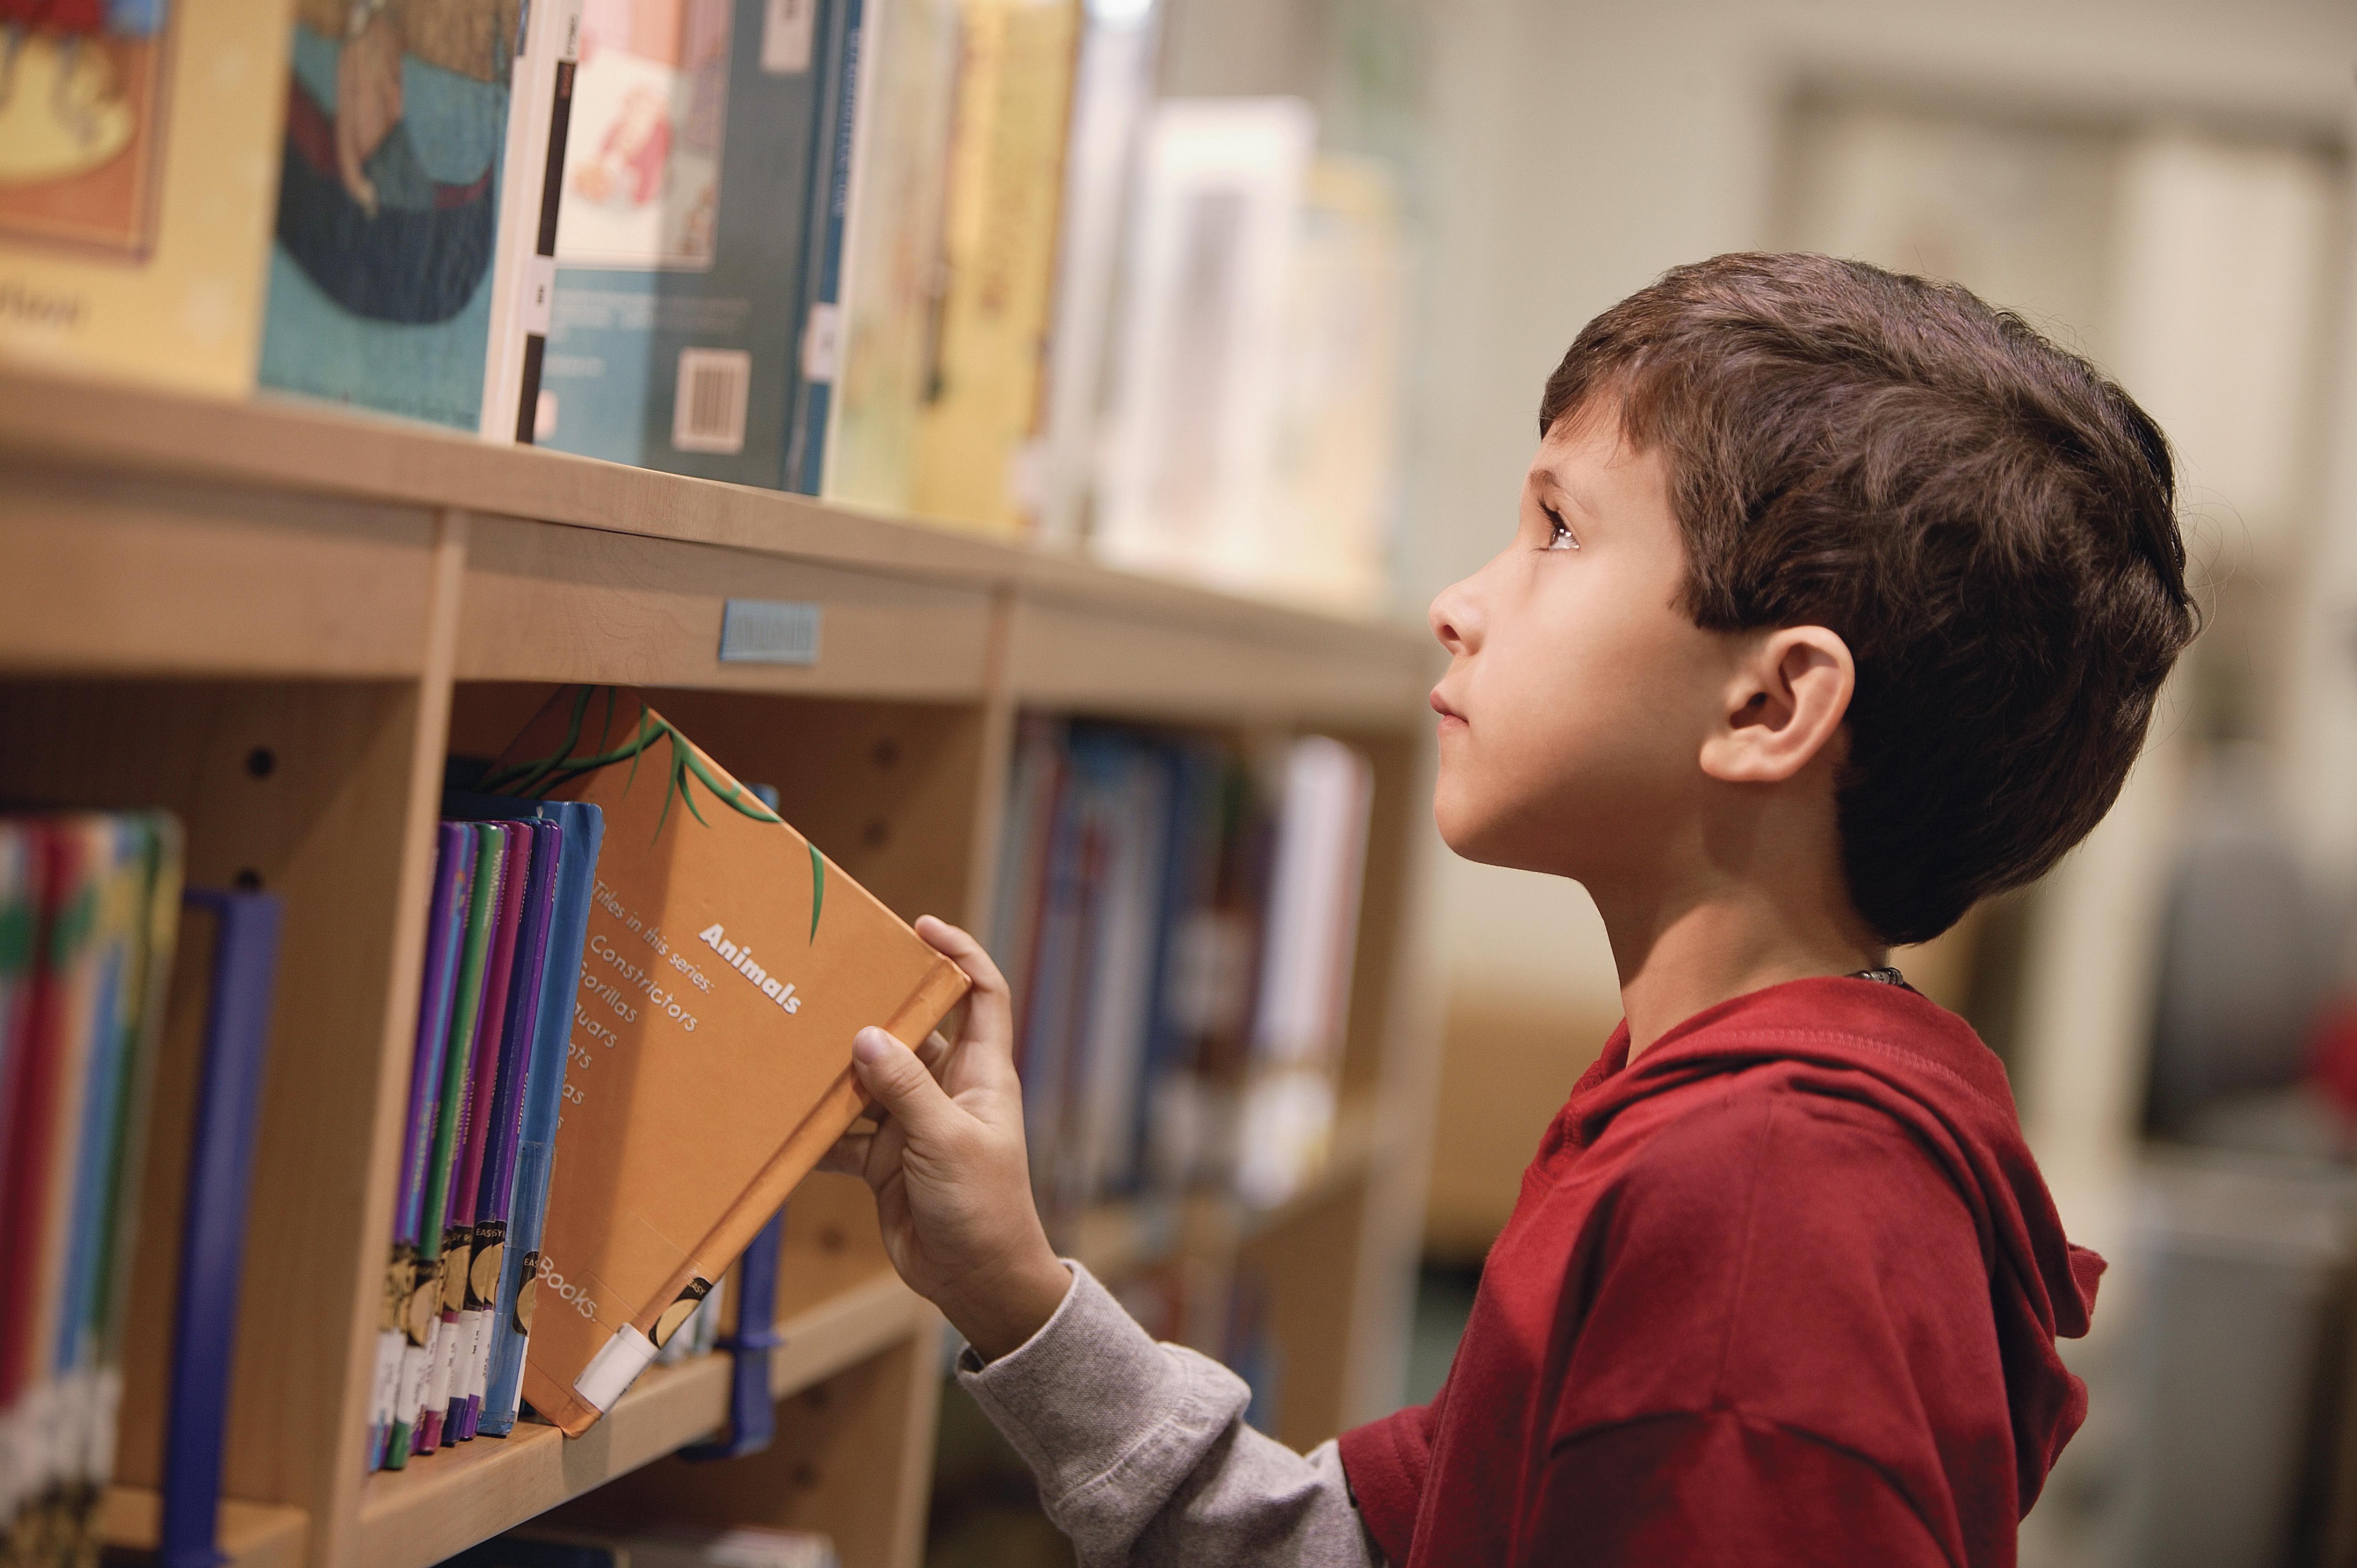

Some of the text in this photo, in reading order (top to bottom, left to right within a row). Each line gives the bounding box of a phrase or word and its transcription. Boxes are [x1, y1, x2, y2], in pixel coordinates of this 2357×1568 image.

[593, 880, 715, 995] Titles in this series:
[698, 923, 801, 1015] Animals
[591, 935, 698, 1032] Constrictors
[476, 1228, 491, 1237] EAS
[524, 1257, 538, 1268] EAS
[538, 1255, 598, 1322] Books.
